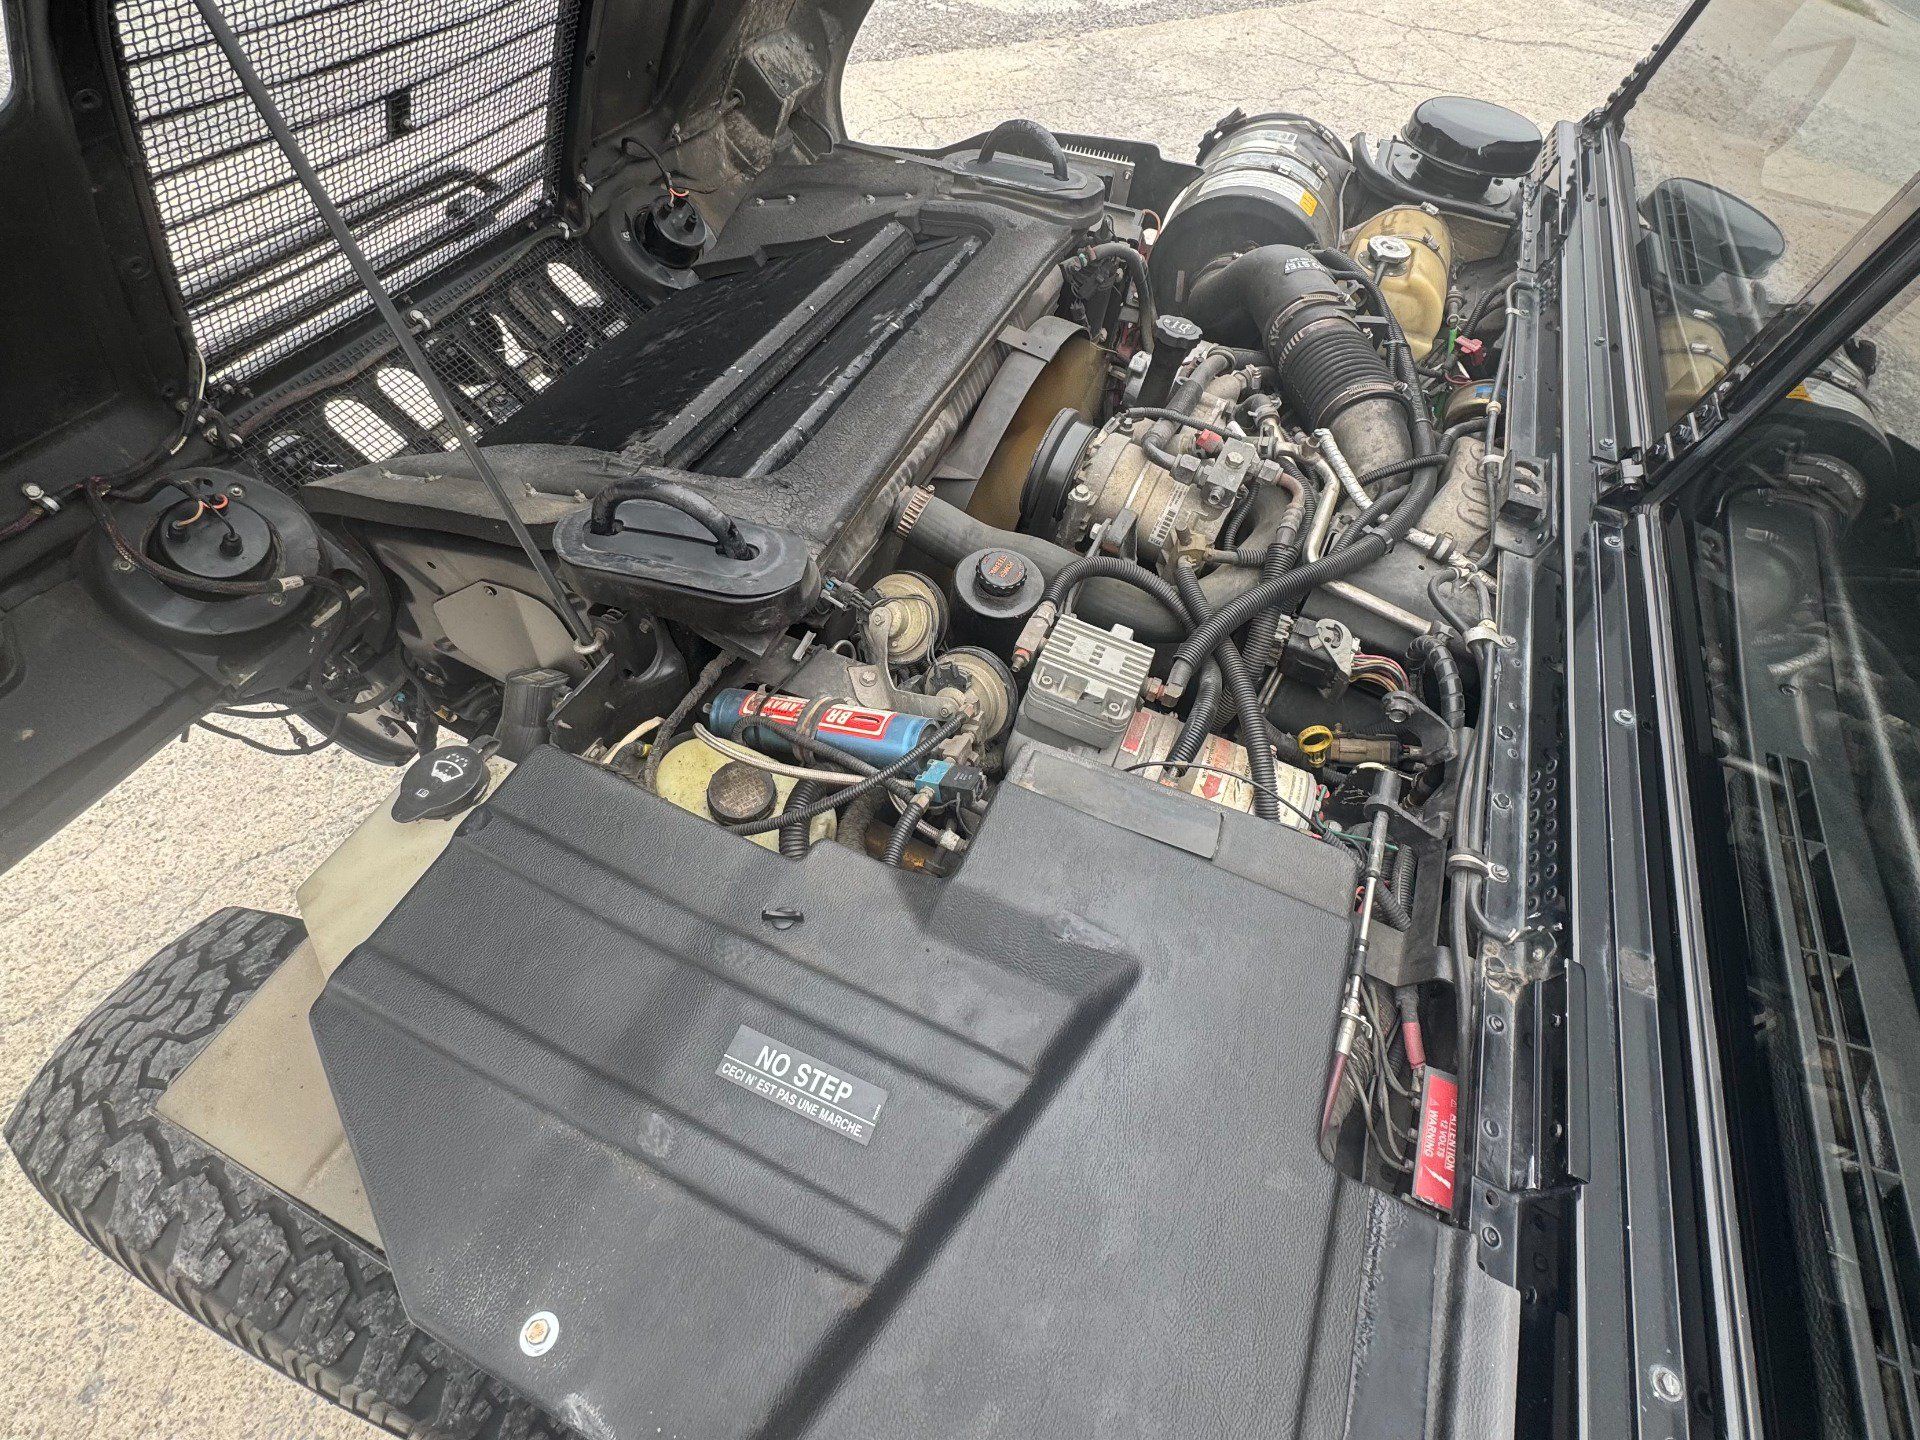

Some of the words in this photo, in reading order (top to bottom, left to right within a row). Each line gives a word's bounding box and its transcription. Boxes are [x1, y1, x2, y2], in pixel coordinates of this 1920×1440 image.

[722, 1062, 747, 1082] CECI
[755, 1079, 778, 1096] EST
[776, 1088, 798, 1106] PAS
[797, 1097, 818, 1117] UNE
[818, 1108, 863, 1138] MARCHE.
[754, 1045, 791, 1077] NO
[793, 1063, 853, 1104] STEP
[1424, 1109, 1438, 1158] WARNING
[1437, 1130, 1447, 1158] VOLTS
[1441, 1119, 1449, 1129] 12
[1445, 1113, 1457, 1172] ATTENTION
